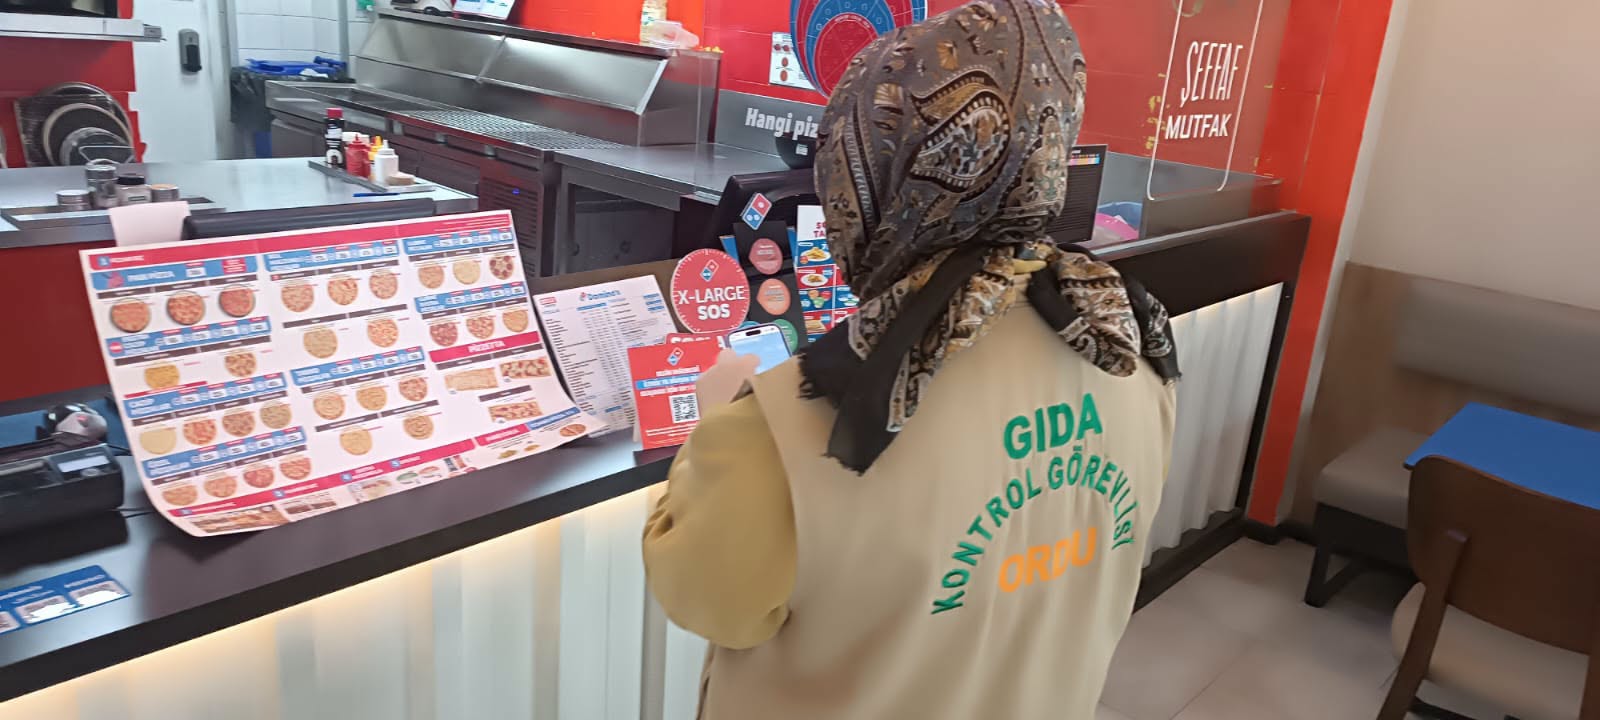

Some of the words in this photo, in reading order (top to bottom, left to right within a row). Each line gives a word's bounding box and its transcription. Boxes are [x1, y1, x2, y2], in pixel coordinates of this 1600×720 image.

[1180, 41, 1243, 108] ŞEFFAF
[745, 107, 793, 138] Hangi
[1165, 113, 1232, 140] MUTFAK
[678, 285, 745, 304] X-LARGE
[697, 303, 731, 320] SOS
[1004, 393, 1103, 459] GIDA
[931, 468, 1042, 615] KONTROL
[1048, 445, 1139, 550] GÖREVLİSİ
[998, 527, 1097, 594] ORDU
